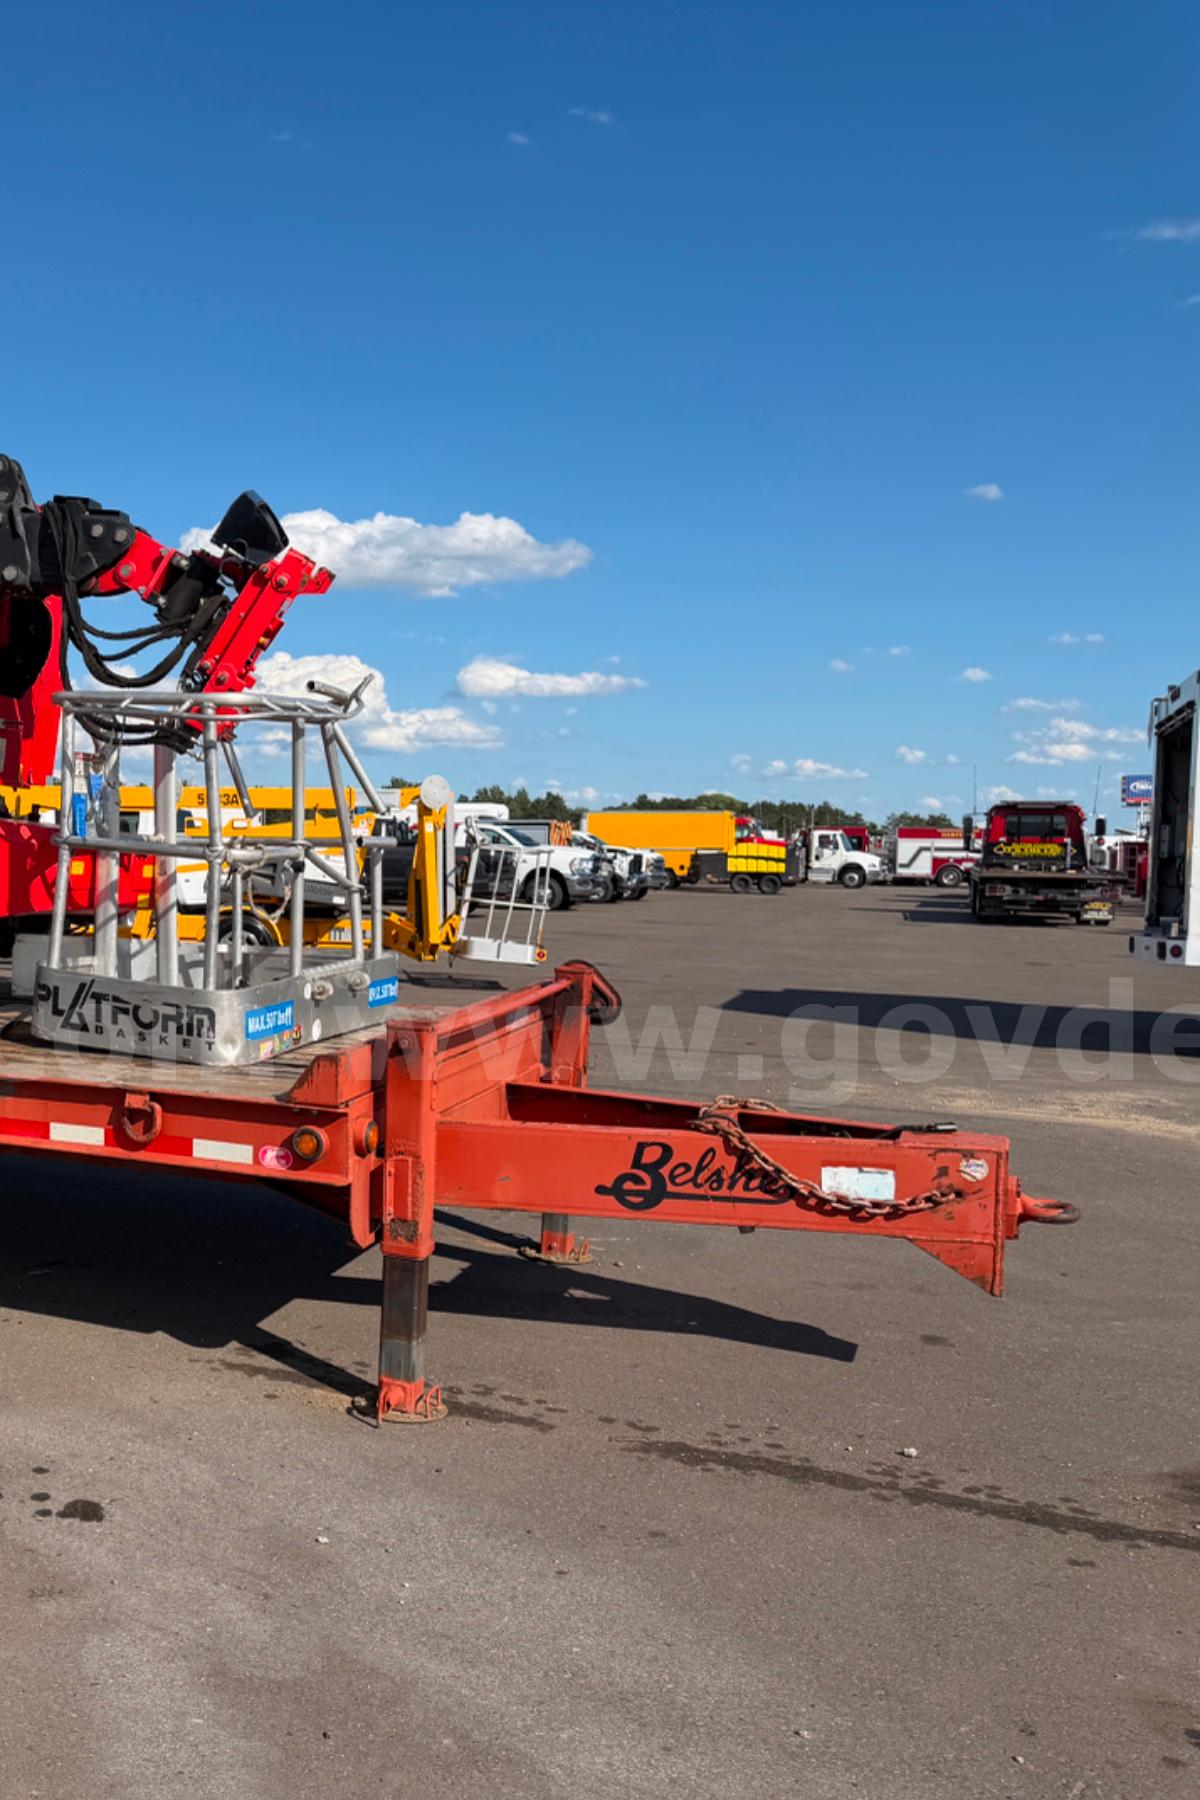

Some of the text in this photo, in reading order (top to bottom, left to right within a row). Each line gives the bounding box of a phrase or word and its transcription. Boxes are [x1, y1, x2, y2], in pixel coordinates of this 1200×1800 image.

[197, 793, 240, 806] 53A
[37, 979, 216, 1039] PLATFORM
[95, 1024, 215, 1051] BASKET
